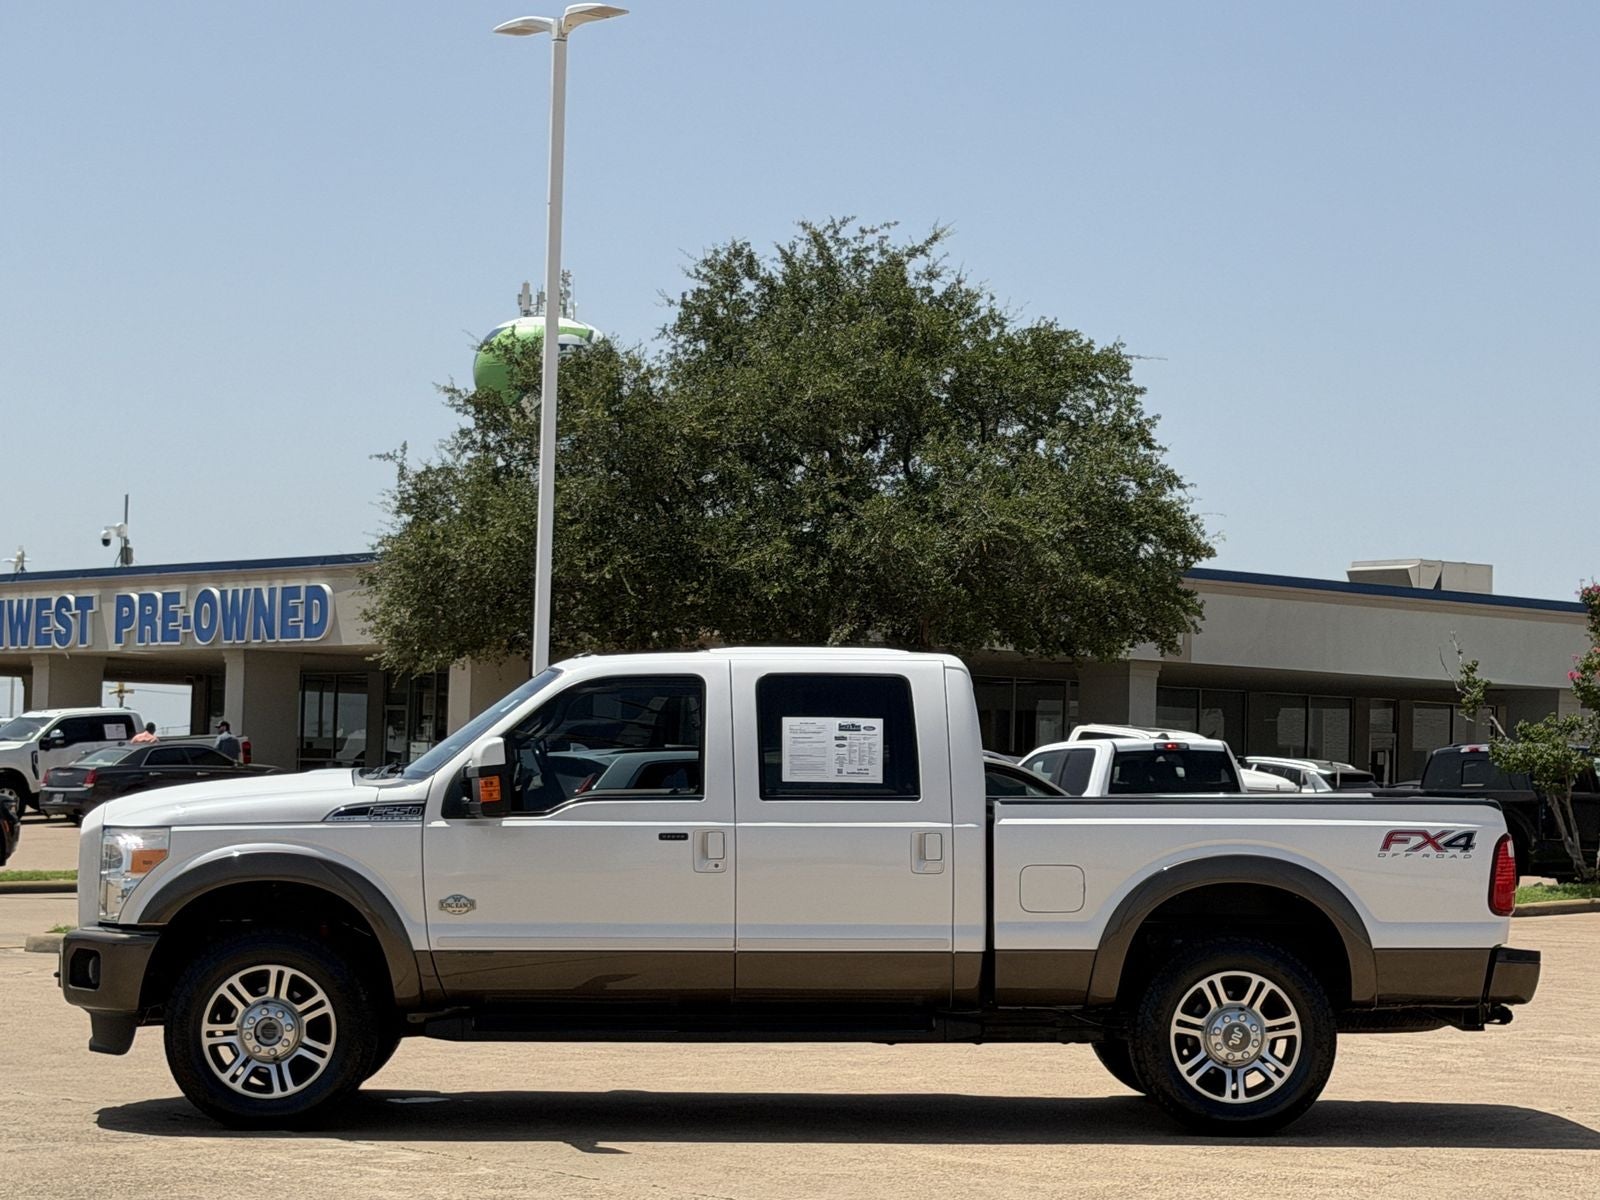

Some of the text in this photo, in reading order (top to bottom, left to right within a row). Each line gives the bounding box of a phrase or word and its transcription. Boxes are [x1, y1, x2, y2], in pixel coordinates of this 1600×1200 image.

[0, 583, 335, 649] WEST PRE-OWNED
[1379, 830, 1477, 852] FX4
